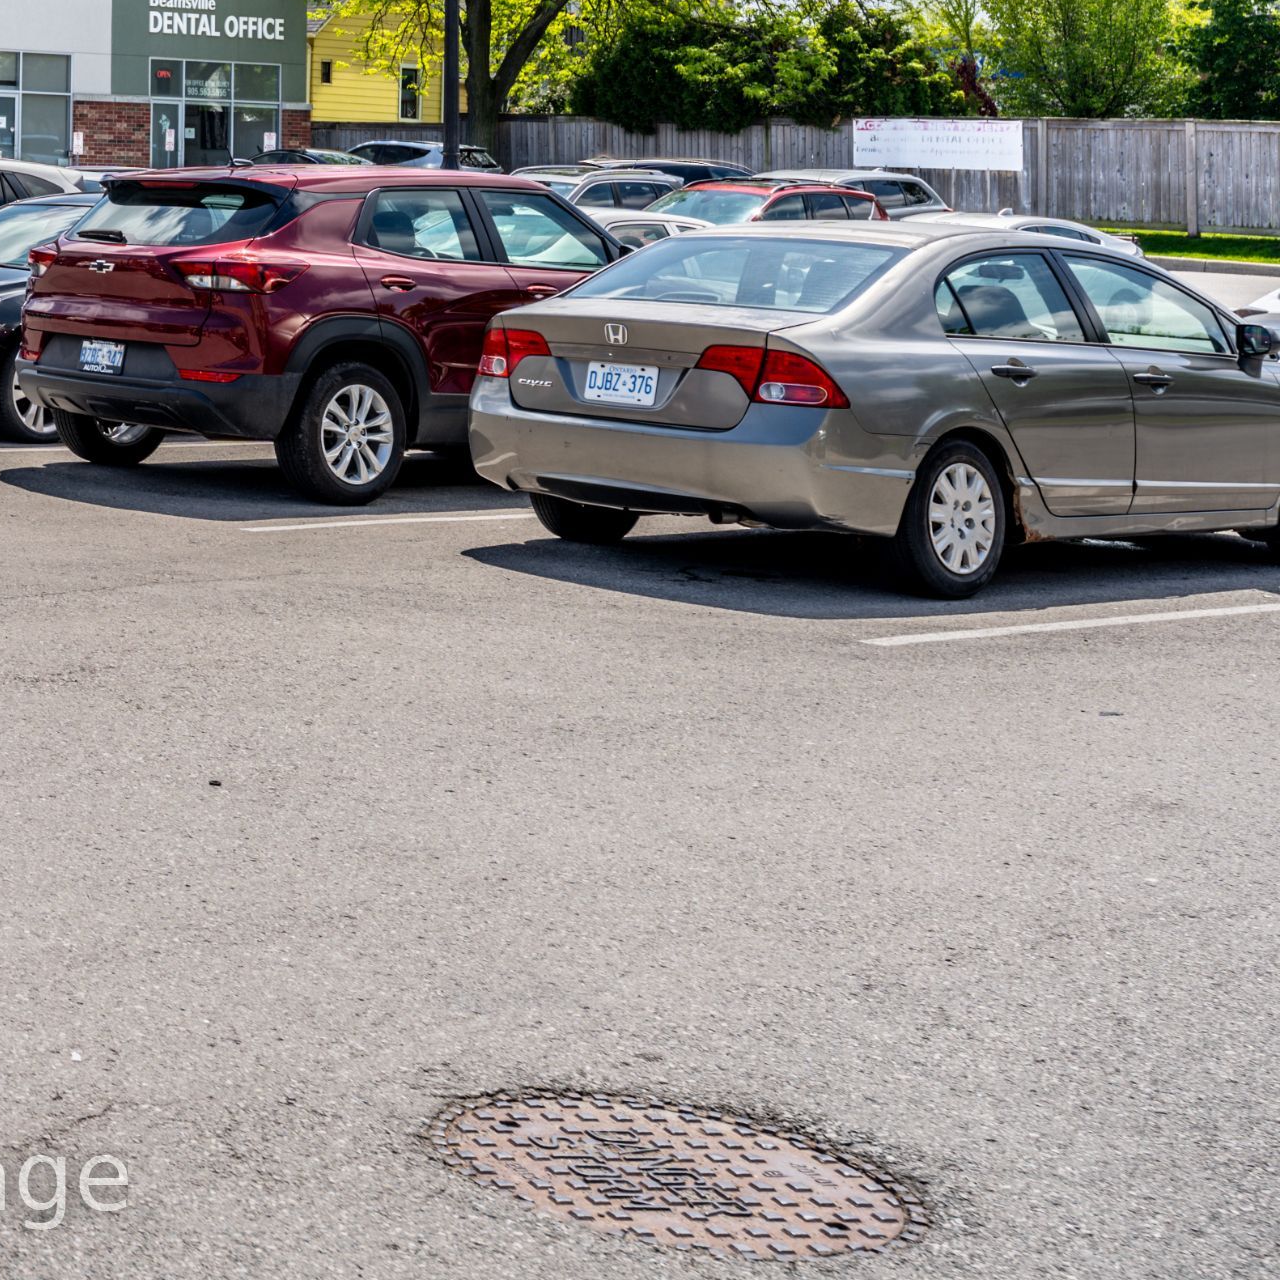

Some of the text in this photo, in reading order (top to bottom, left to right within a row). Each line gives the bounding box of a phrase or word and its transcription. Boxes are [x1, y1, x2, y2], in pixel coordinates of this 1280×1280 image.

[148, 11, 285, 41] DENTAL OFFICE
[518, 378, 553, 387] CIVIC
[588, 370, 654, 395] DJBZ 376
